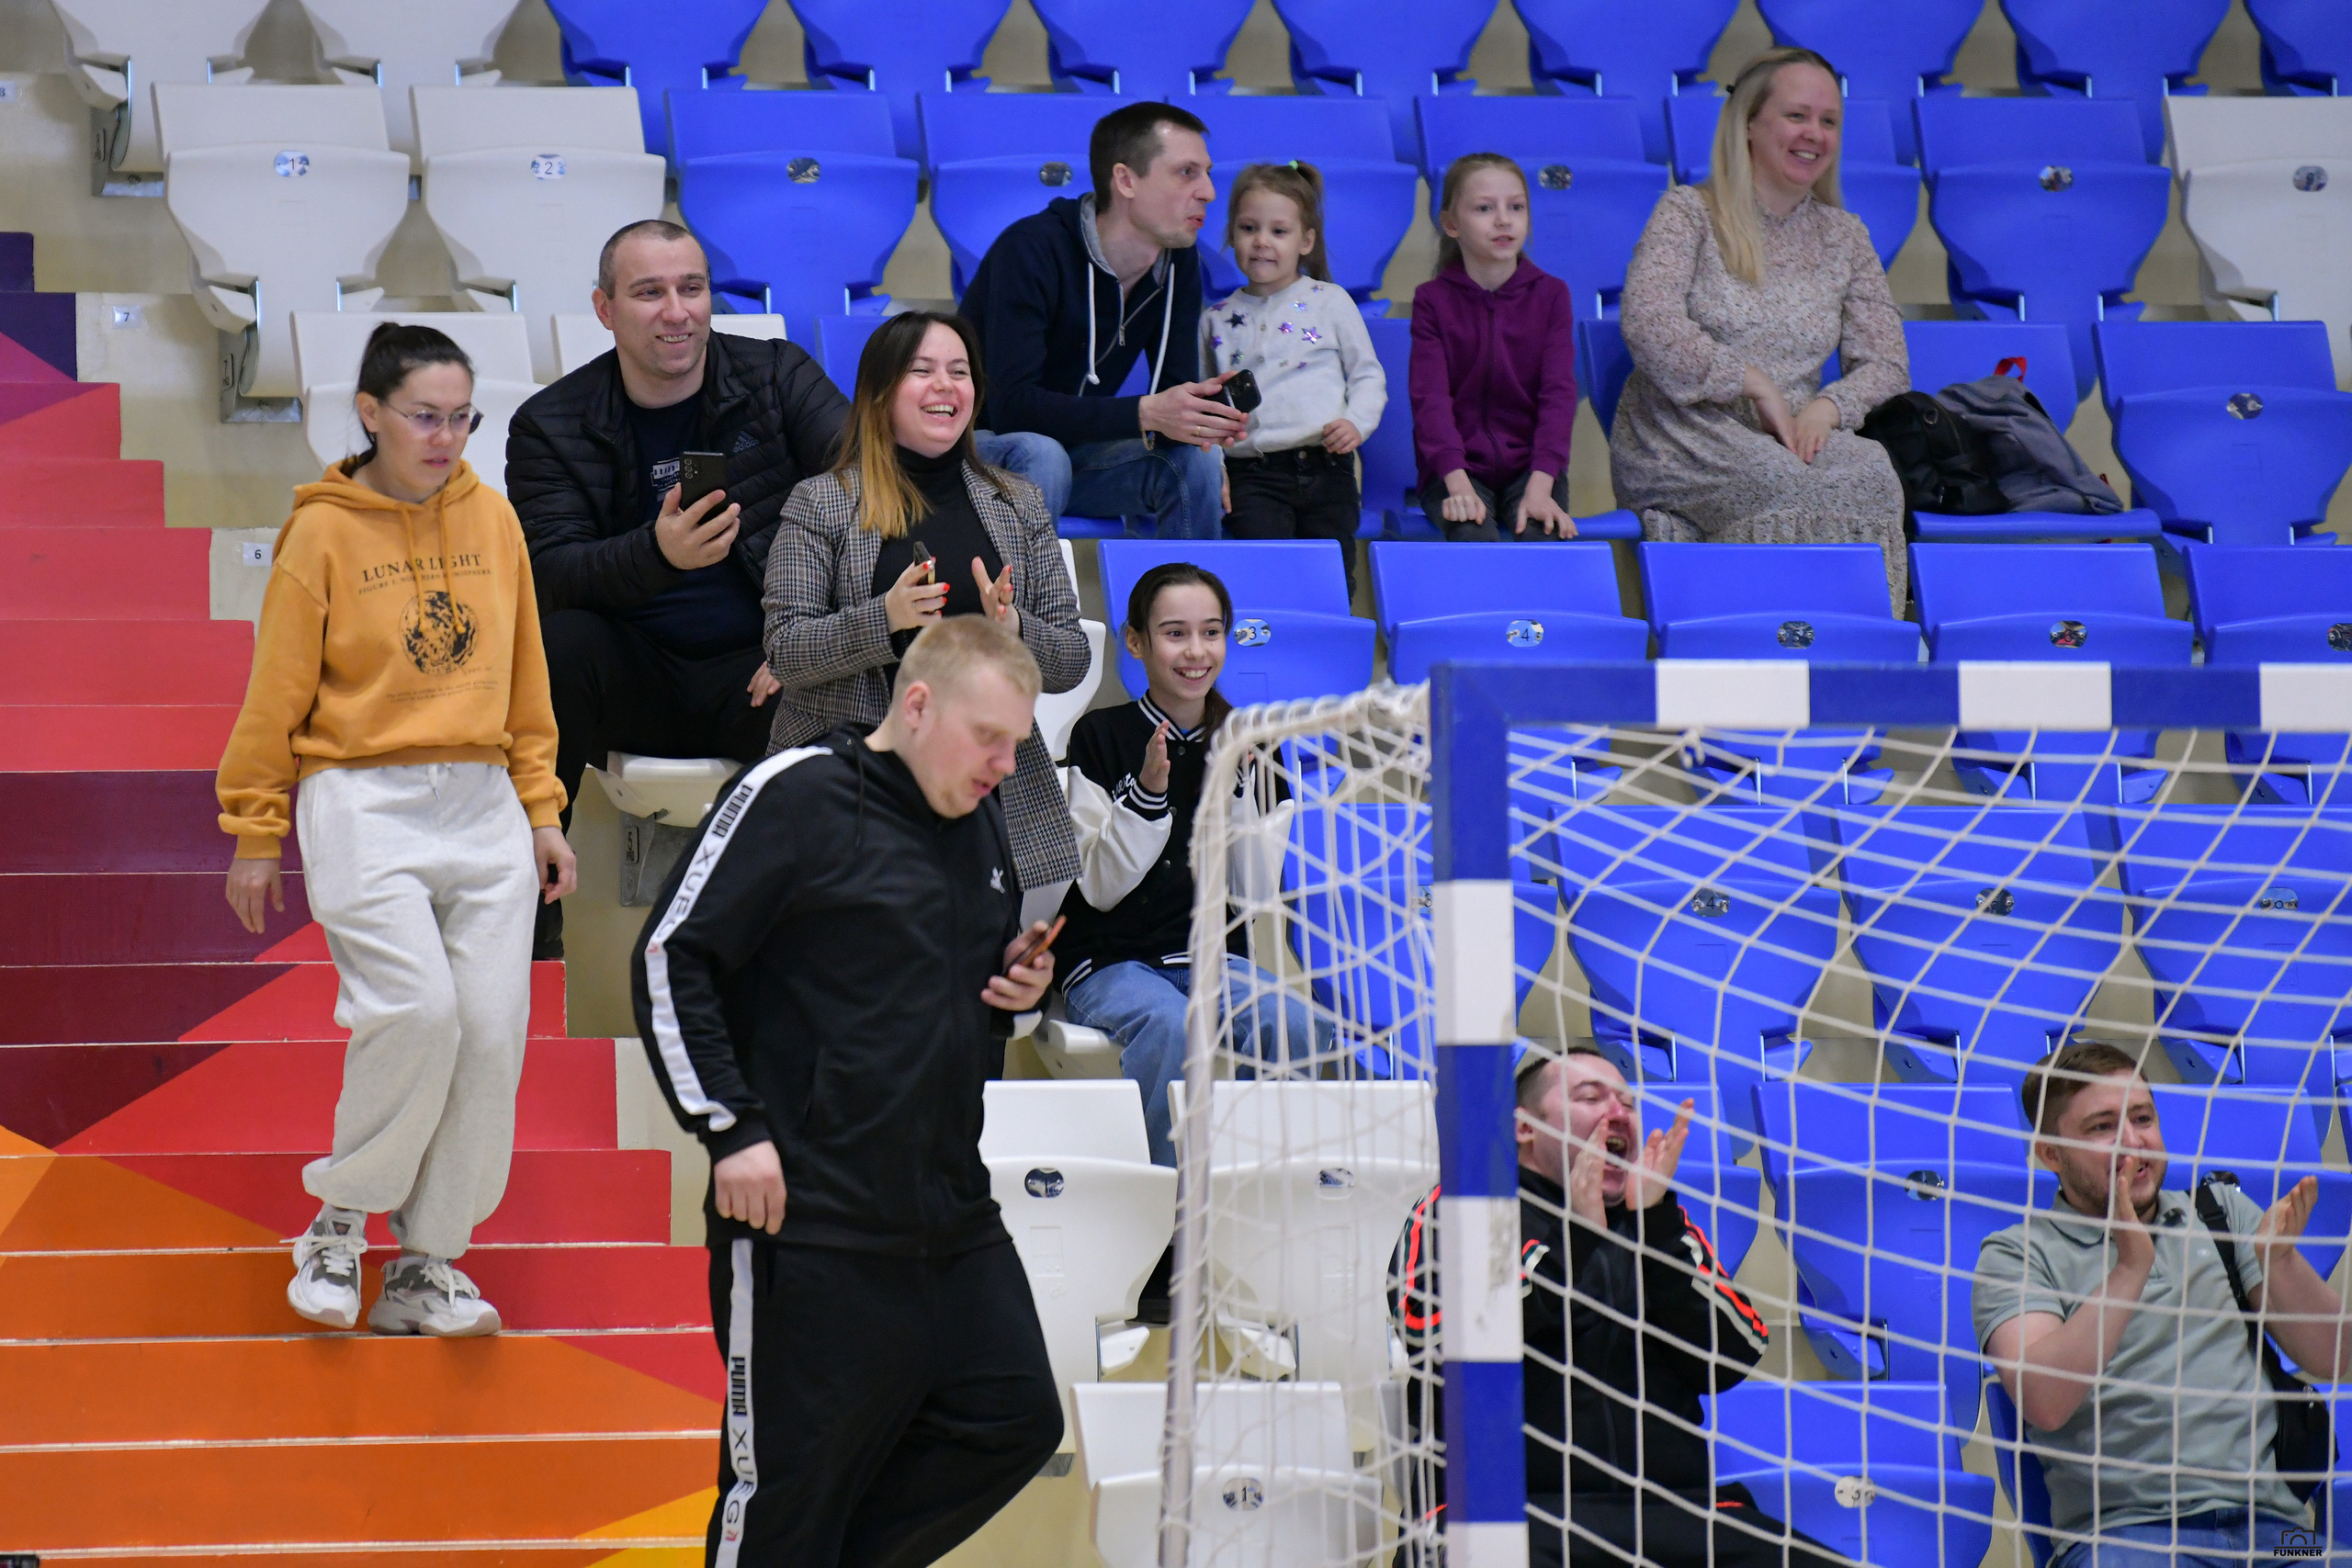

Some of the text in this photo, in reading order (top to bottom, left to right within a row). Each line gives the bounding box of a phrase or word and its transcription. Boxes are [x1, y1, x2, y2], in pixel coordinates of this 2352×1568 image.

[288, 157, 296, 171] 1
[544, 161, 553, 175] 2
[123, 311, 130, 322] 7
[254, 549, 262, 560] 6
[363, 558, 424, 582] LUNAR
[1249, 626, 1257, 640] 3
[1521, 628, 1531, 642] 4
[711, 783, 754, 838] PUMA
[1706, 896, 1716, 909] 4
[730, 1356, 749, 1416] PUMA
[1241, 1486, 1248, 1502] 1
